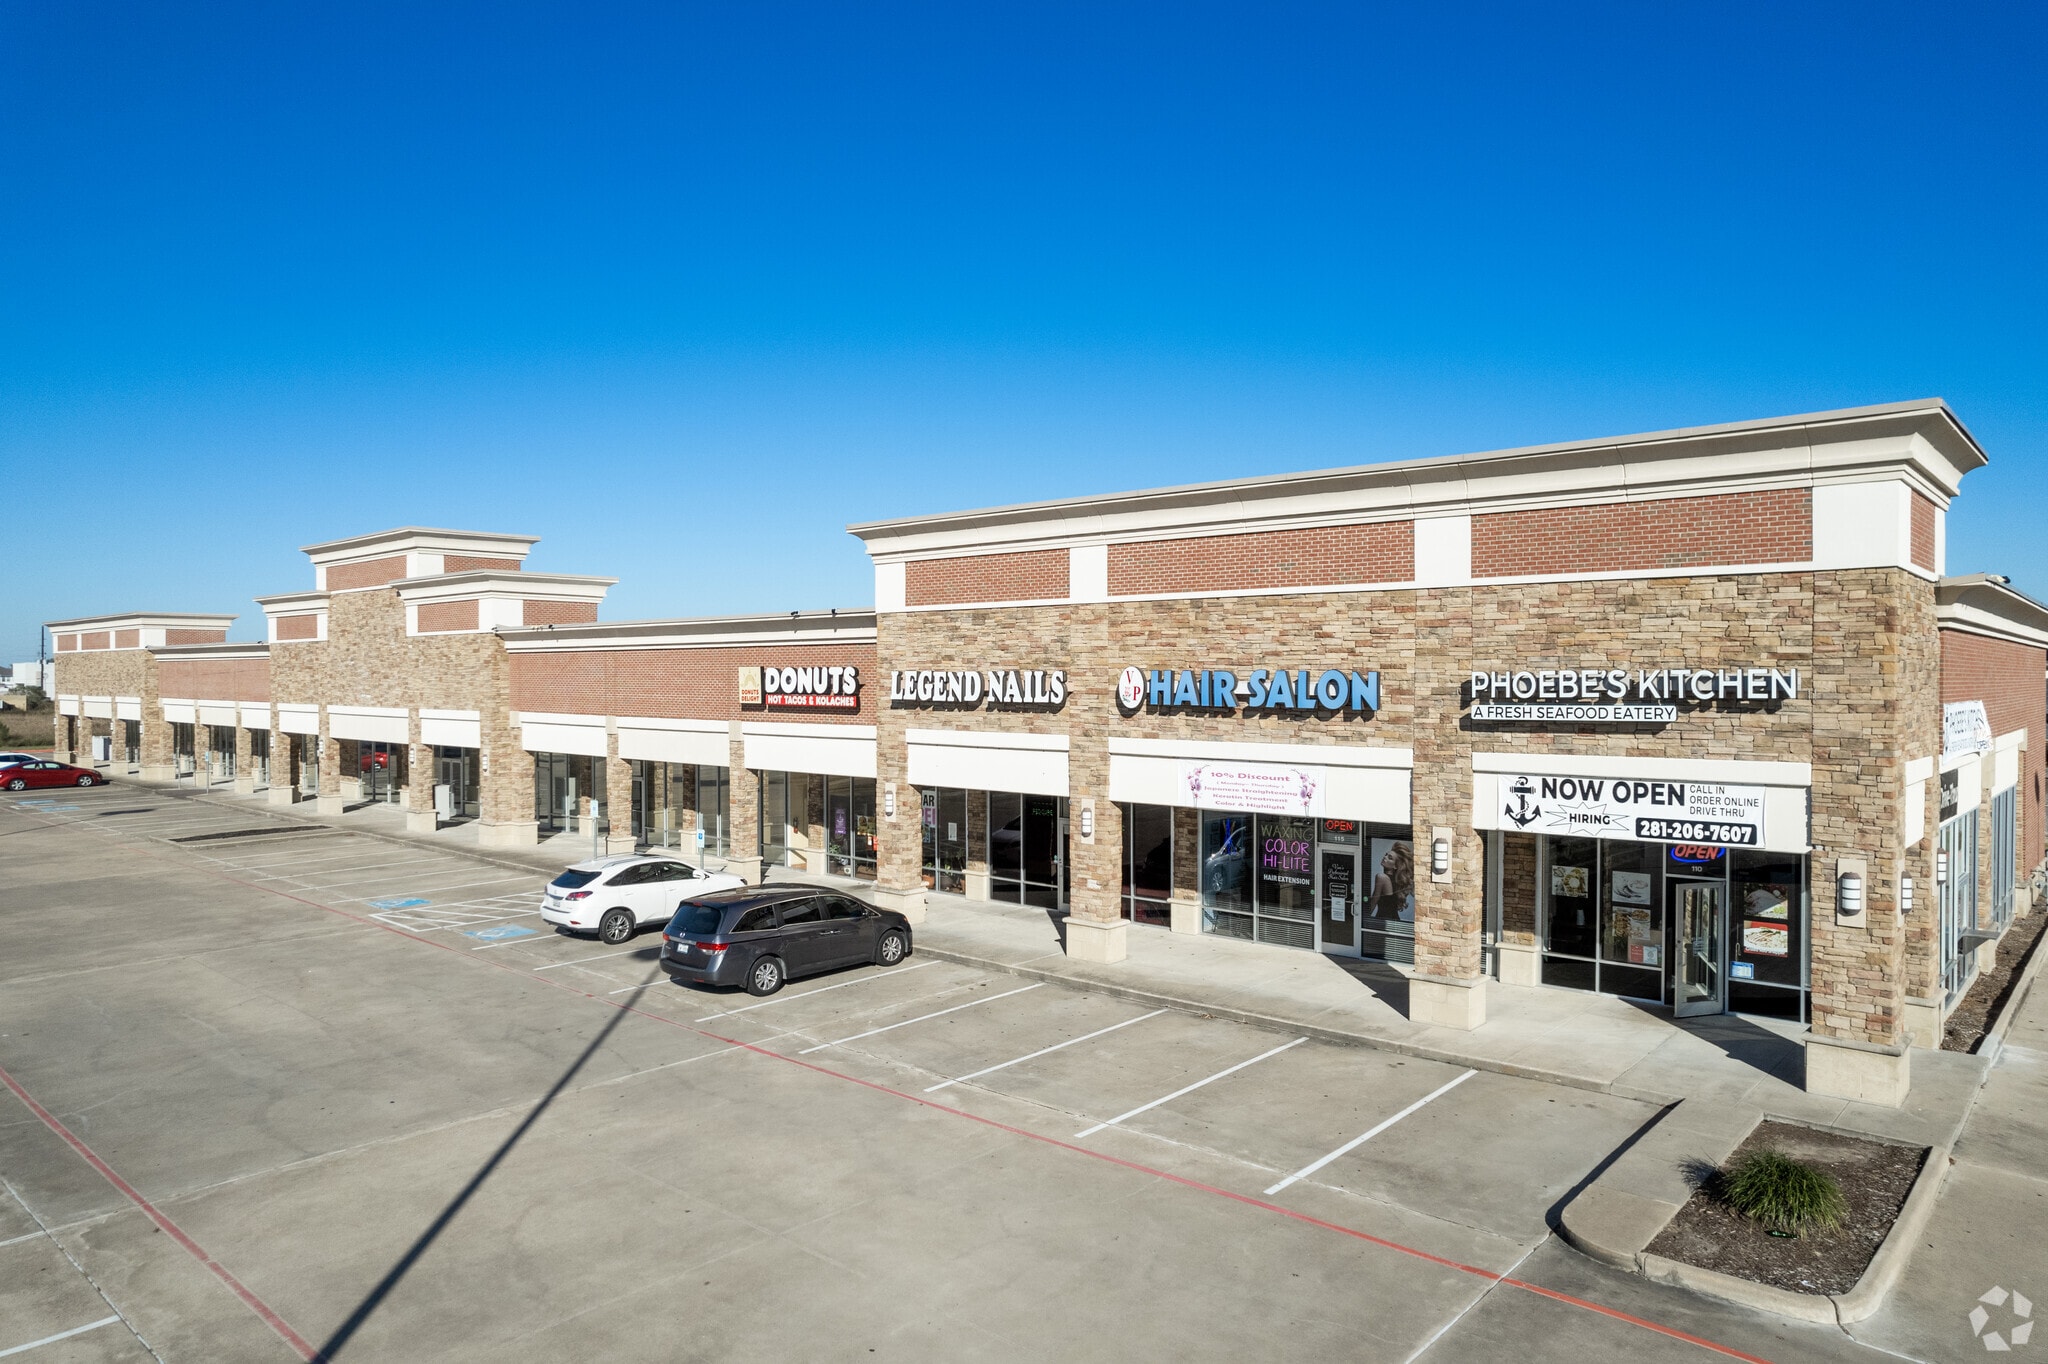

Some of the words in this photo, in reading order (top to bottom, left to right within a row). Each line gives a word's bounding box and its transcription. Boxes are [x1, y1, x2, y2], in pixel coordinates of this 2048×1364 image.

[765, 666, 856, 695] DONUTS
[890, 670, 982, 702] LEGEND
[987, 670, 1065, 704] NAILS
[1471, 669, 1628, 699] PHOEBE'S
[1639, 668, 1797, 700] KITCHEN
[1150, 669, 1239, 708] HAIR
[1249, 669, 1379, 711] SALON
[767, 695, 782, 704] HOT
[784, 696, 806, 705] TACOS
[809, 696, 814, 705] &
[816, 696, 855, 706] KOLACHES
[1473, 706, 1483, 718] A
[1487, 707, 1532, 718] FRESH
[1537, 707, 1609, 719] SEAFOOD
[1613, 708, 1674, 720] EATERY
[1238, 773, 1291, 781] Discount
[1542, 778, 1604, 801] NOW
[1612, 781, 1685, 806] OPEN
[1690, 785, 1713, 794] CALL
[1716, 786, 1725, 795] IN
[1690, 796, 1721, 805] ORDER
[1724, 797, 1759, 807] ONLINE
[1569, 813, 1611, 825] HIRING
[1690, 806, 1717, 816] DRIVE
[1720, 808, 1745, 818] THRU
[1261, 824, 1314, 841] WAXING
[1326, 820, 1353, 831] OPEN
[1640, 820, 1752, 843] 281-206-7607
[1265, 839, 1309, 856] COLOR
[1674, 844, 1719, 859] OPEN
[1263, 854, 1310, 872] HI-LITE
[1263, 874, 1277, 882] HAIR
[1278, 876, 1310, 886] EXTENSION
